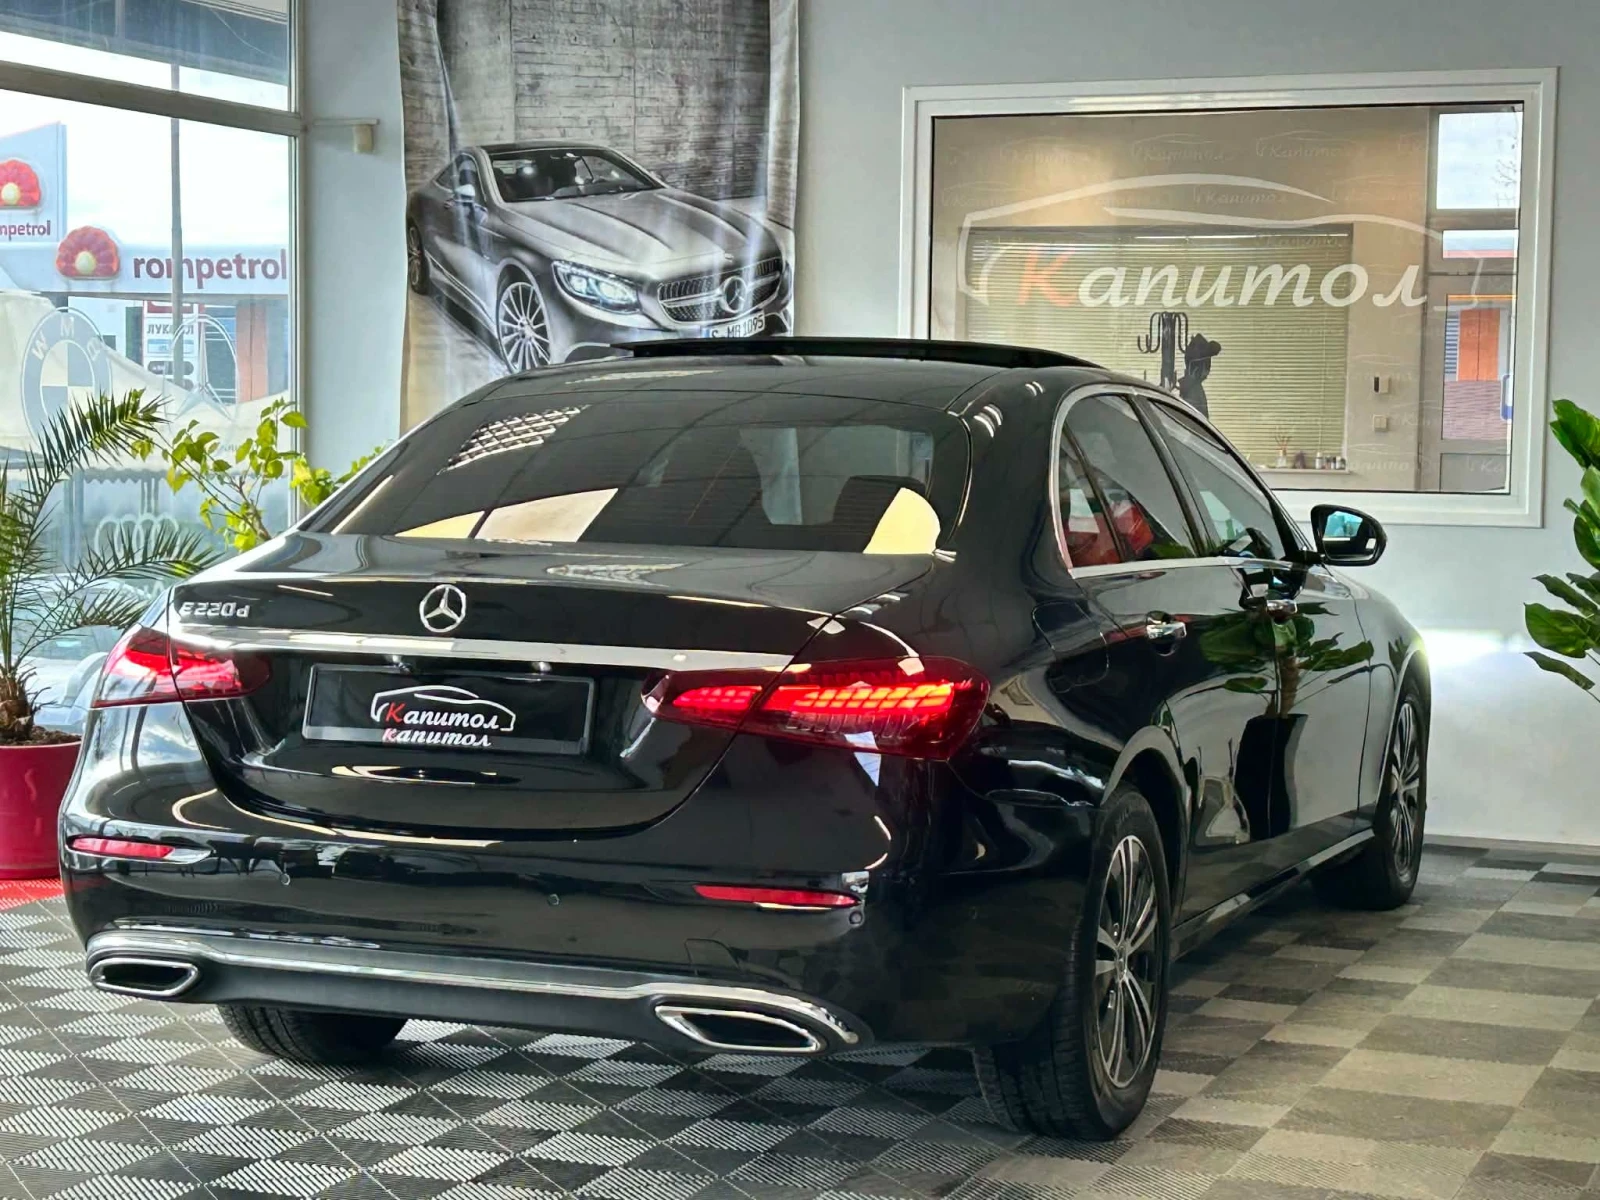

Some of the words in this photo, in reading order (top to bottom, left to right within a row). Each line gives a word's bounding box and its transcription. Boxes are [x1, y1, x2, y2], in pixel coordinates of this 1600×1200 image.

[133, 248, 287, 290] rompetrol
[1015, 247, 1427, 307] Капитол
[146, 324, 194, 335] ЛУКЛ
[743, 313, 764, 336] 1095
[385, 701, 500, 729] Капитол
